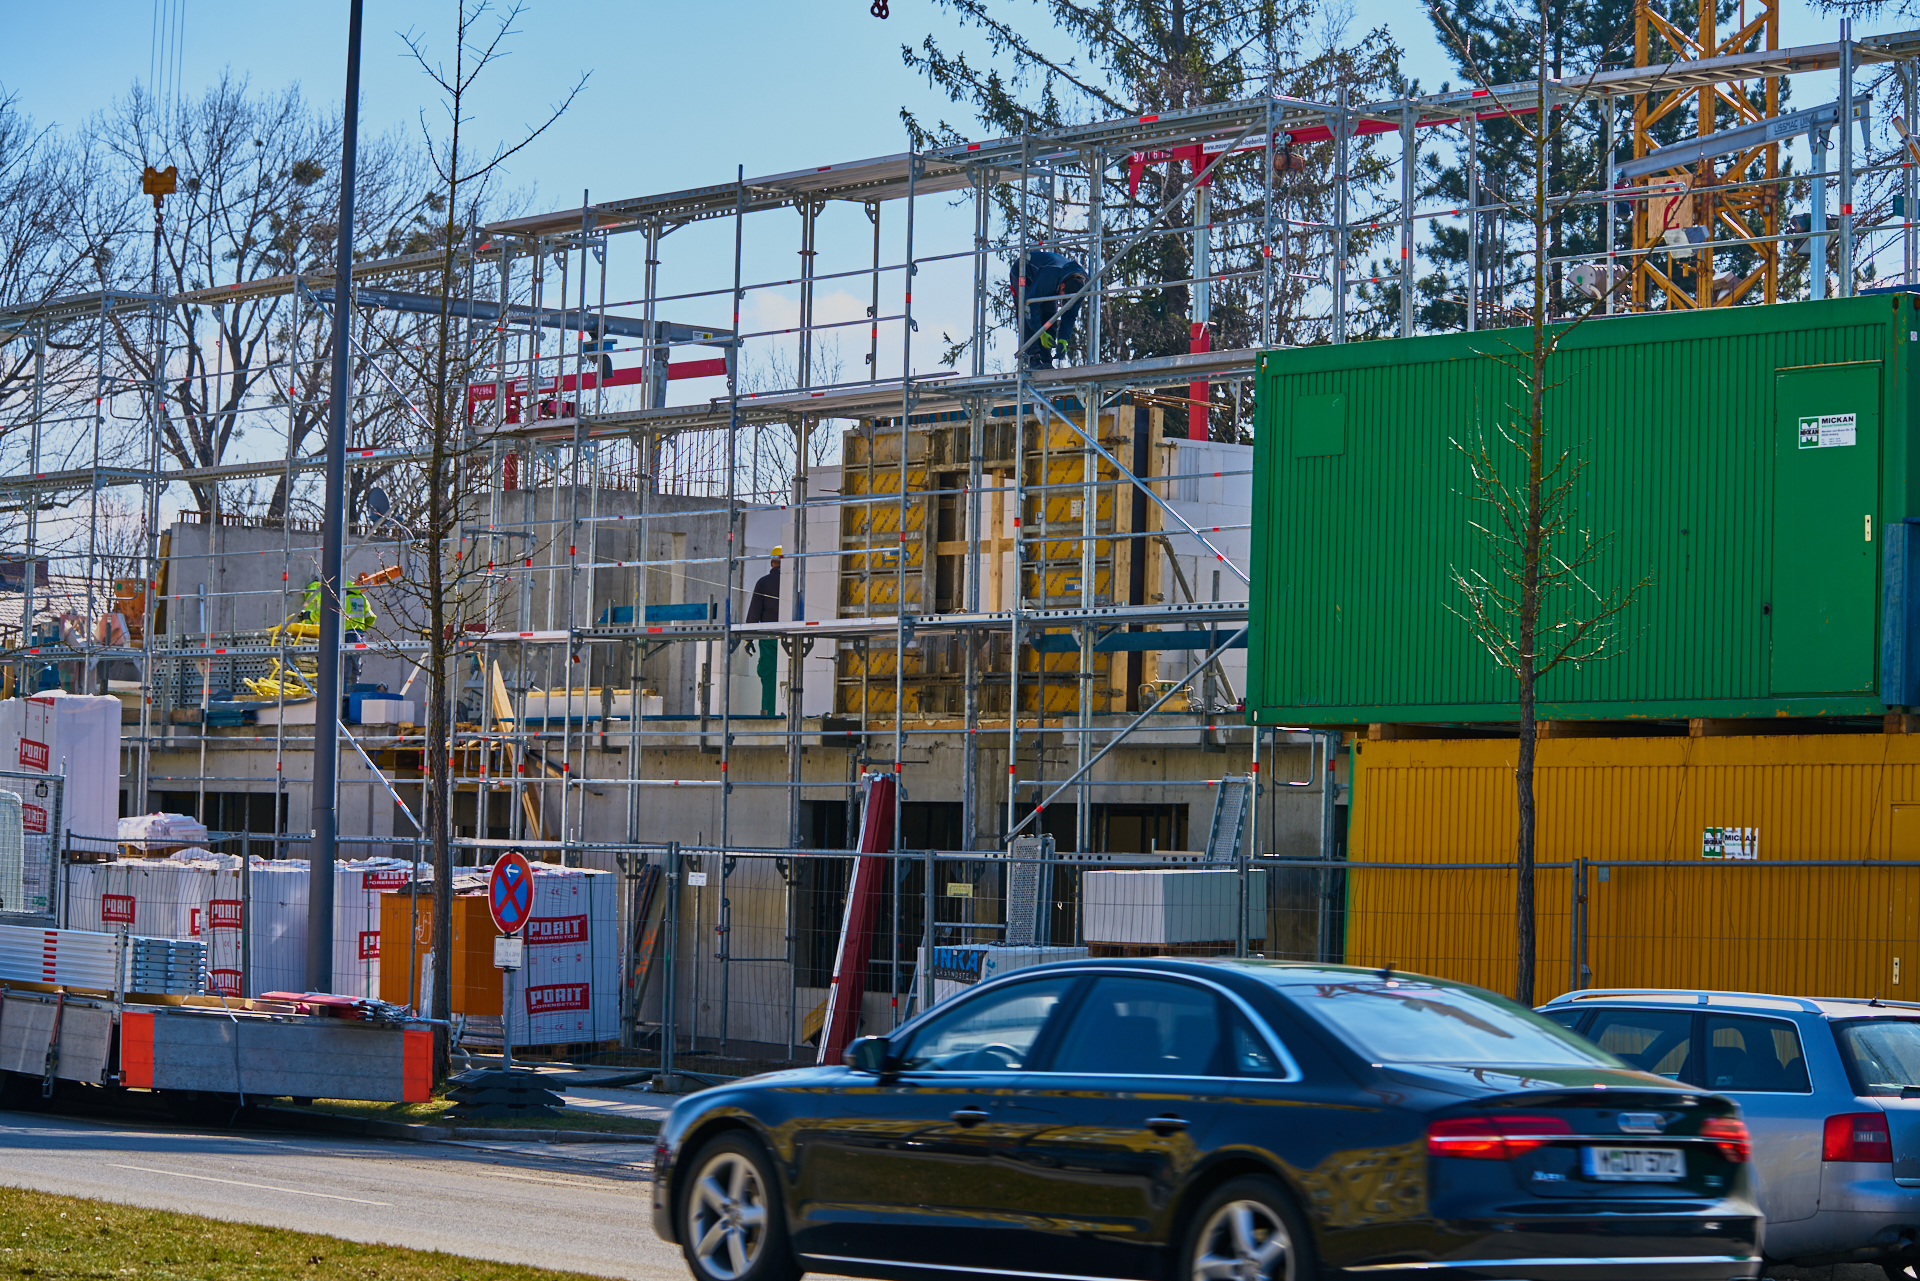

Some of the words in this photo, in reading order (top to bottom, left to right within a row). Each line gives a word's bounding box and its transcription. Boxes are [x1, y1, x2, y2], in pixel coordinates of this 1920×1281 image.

[1774, 120, 1798, 133] LISSMAC
[1821, 416, 1854, 424] MICKAN
[22, 742, 46, 761] PORIT
[104, 898, 132, 914] PORIT
[211, 904, 241, 919] PORIT
[529, 920, 581, 936] PORIT
[530, 987, 583, 1005] PORIT
[531, 1001, 581, 1010] PORENBETON
